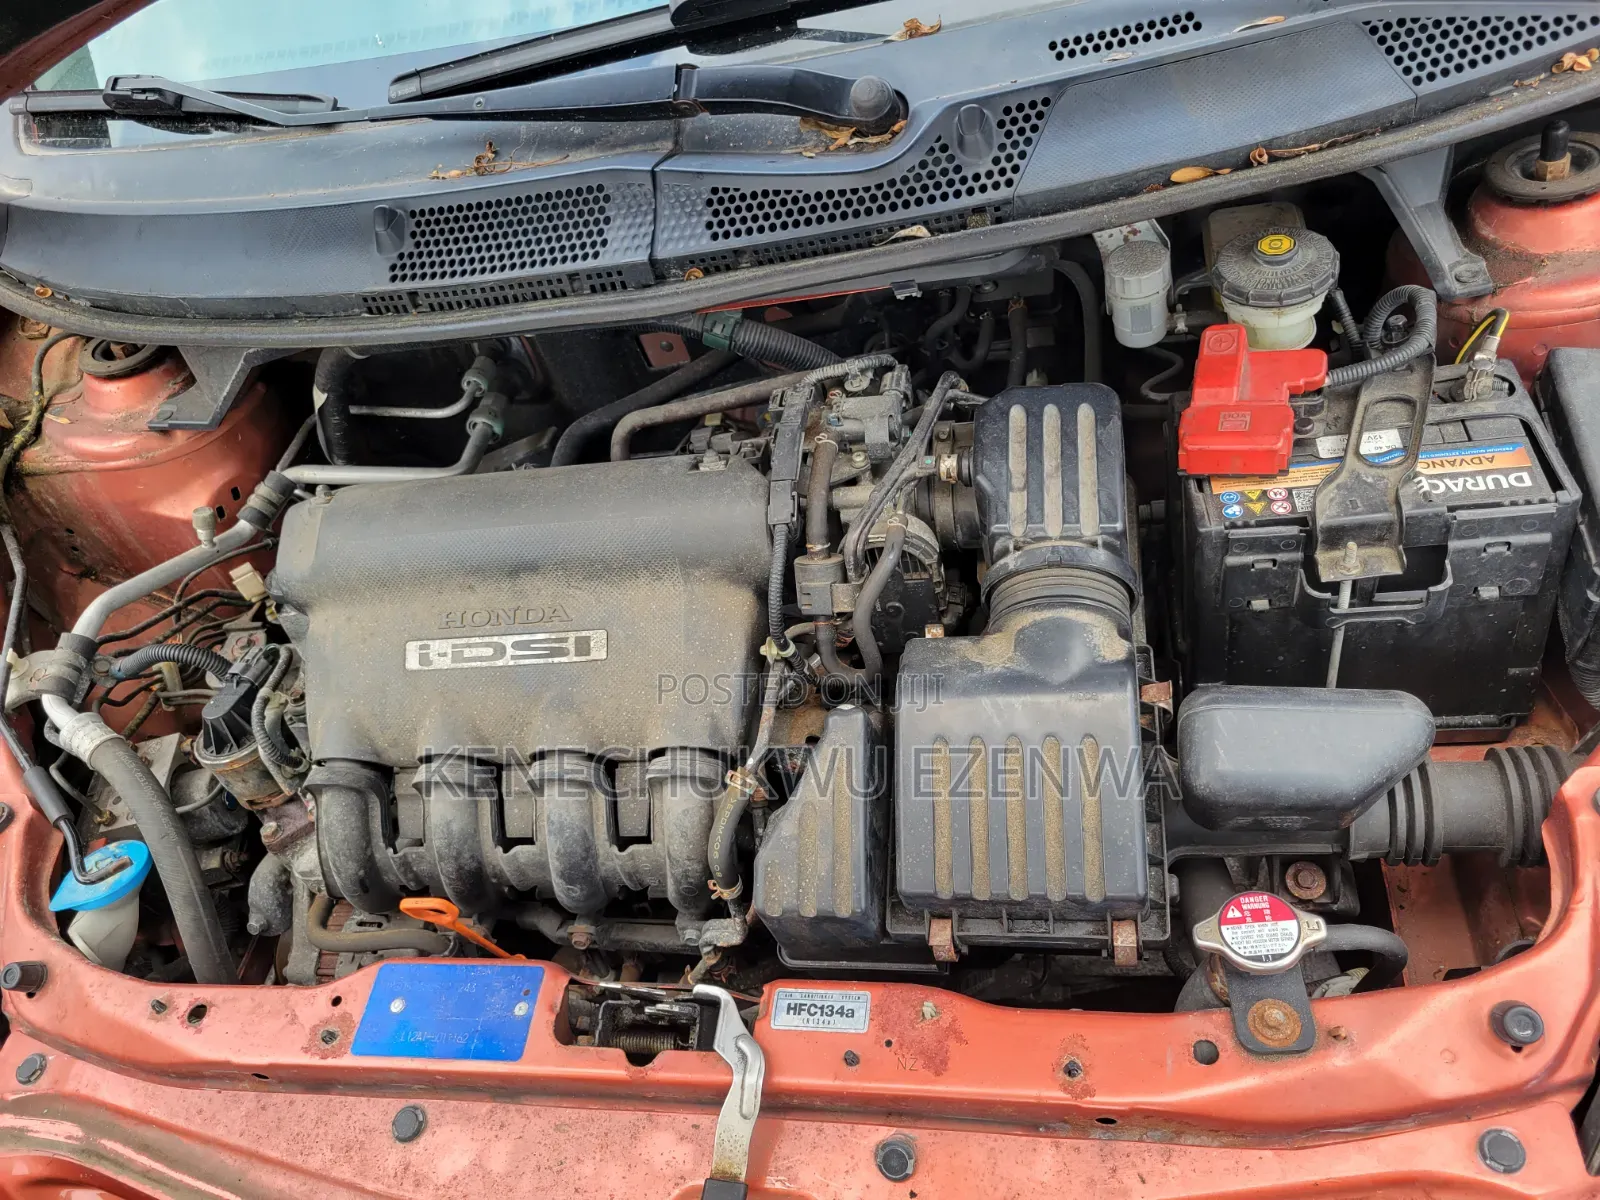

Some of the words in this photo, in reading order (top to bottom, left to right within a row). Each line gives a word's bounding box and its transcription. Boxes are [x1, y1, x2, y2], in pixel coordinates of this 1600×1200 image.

[1419, 454, 1496, 470] ADVANC
[1413, 471, 1533, 495] DURACE
[438, 604, 573, 630] HONDA
[1240, 895, 1268, 904] DANGER
[786, 1002, 855, 1019] HFC134a
[896, 1056, 919, 1072] NZ
